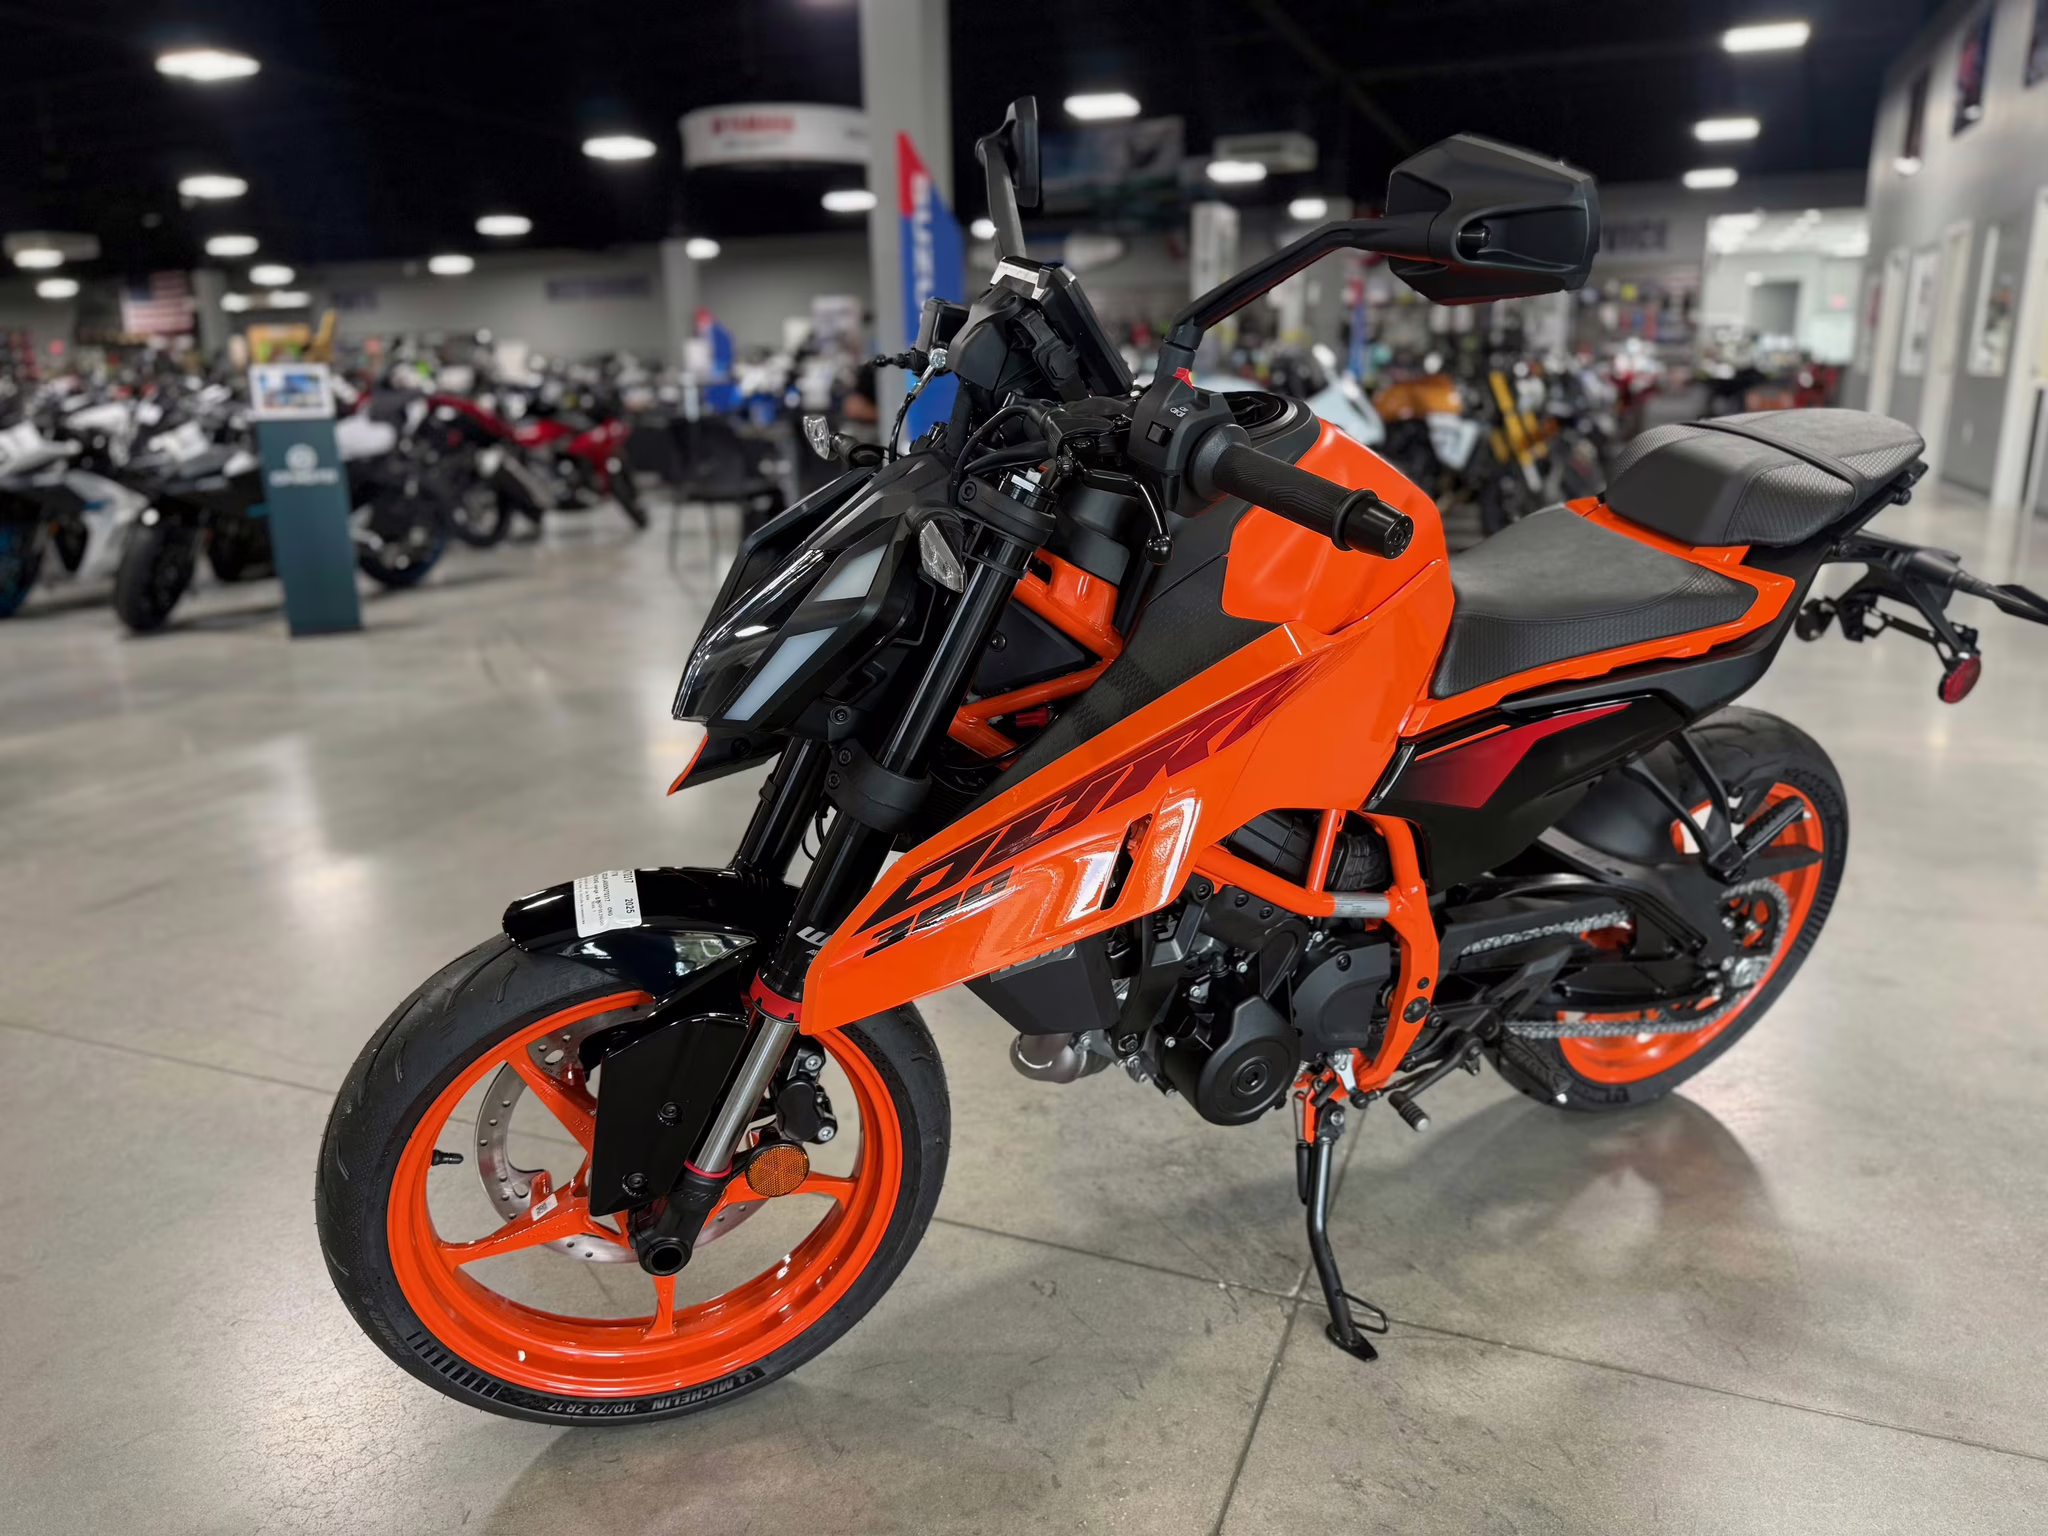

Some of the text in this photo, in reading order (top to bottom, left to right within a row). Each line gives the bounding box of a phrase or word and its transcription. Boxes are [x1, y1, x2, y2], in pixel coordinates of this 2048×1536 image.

[625, 898, 636, 914] 2025
[652, 1378, 734, 1410] MICHELIN
[547, 1402, 637, 1414] 110/70 ZR 17
